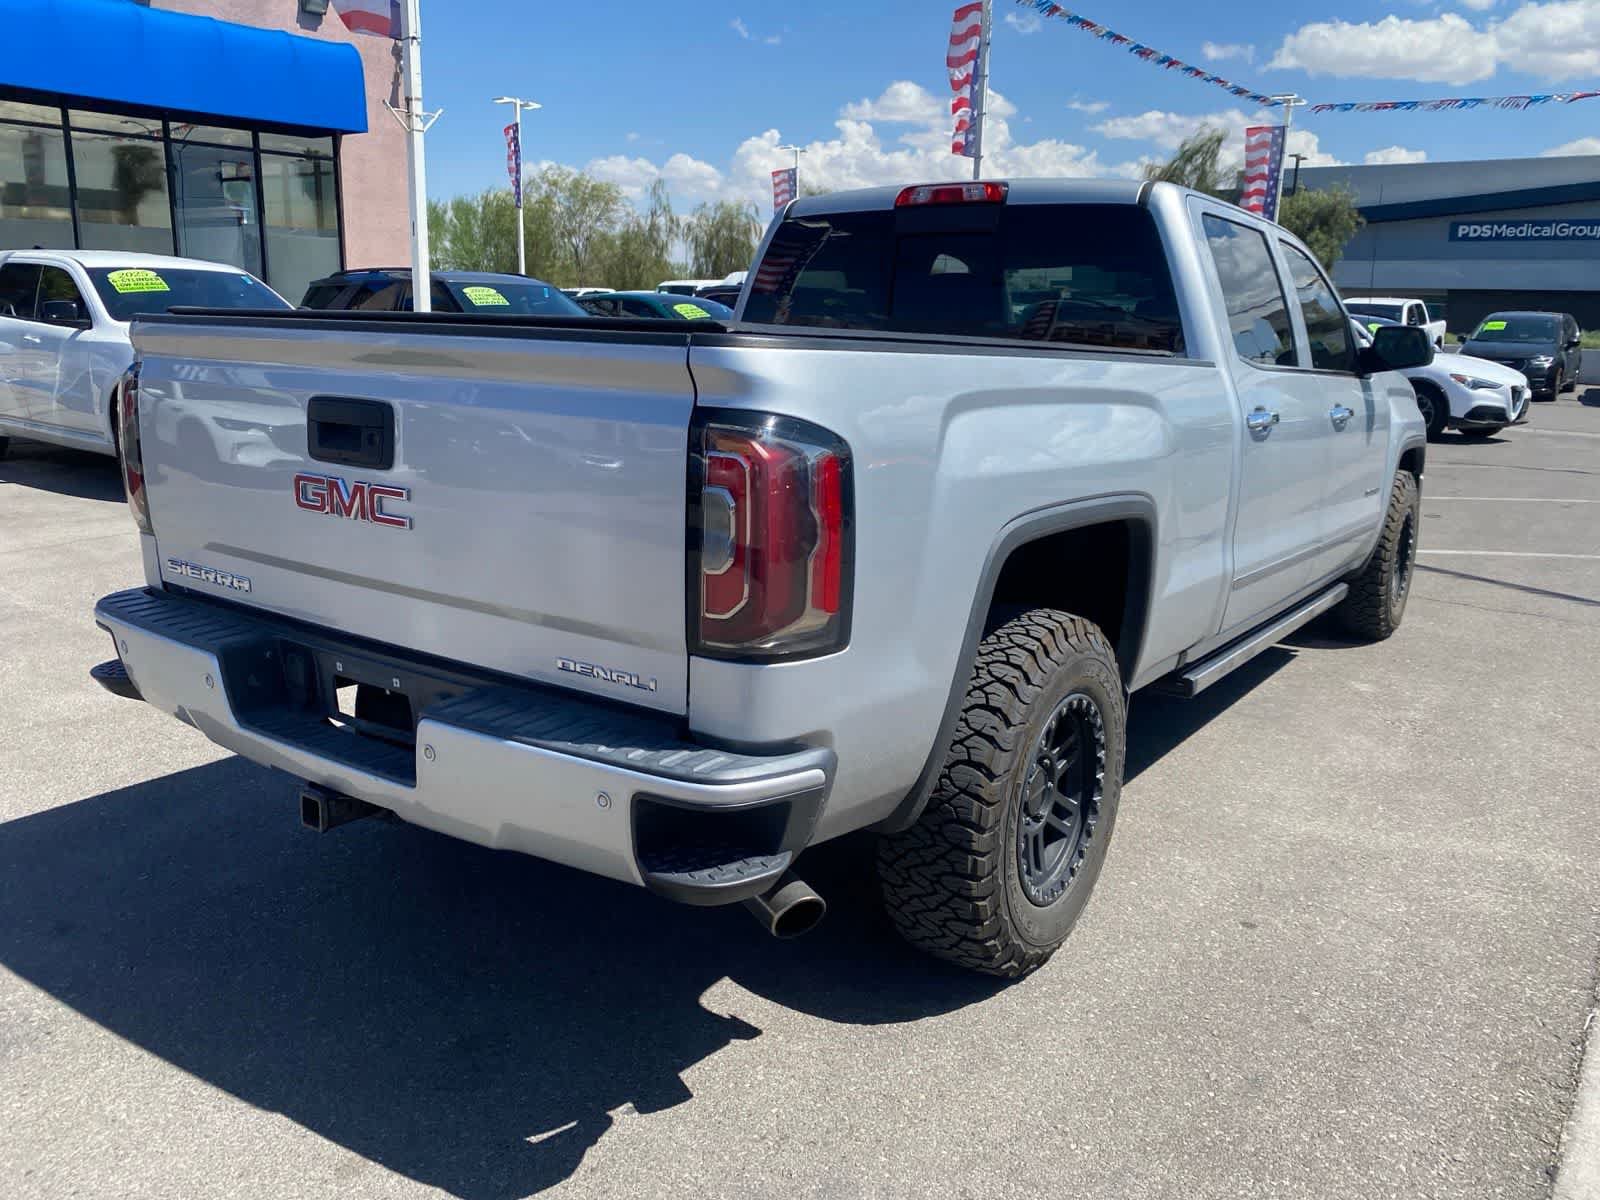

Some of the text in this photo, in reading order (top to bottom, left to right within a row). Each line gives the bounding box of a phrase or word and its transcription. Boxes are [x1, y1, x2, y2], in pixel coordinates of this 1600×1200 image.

[294, 472, 413, 530] GMC
[167, 558, 252, 593] SIERRA
[556, 656, 658, 693] DENALI
